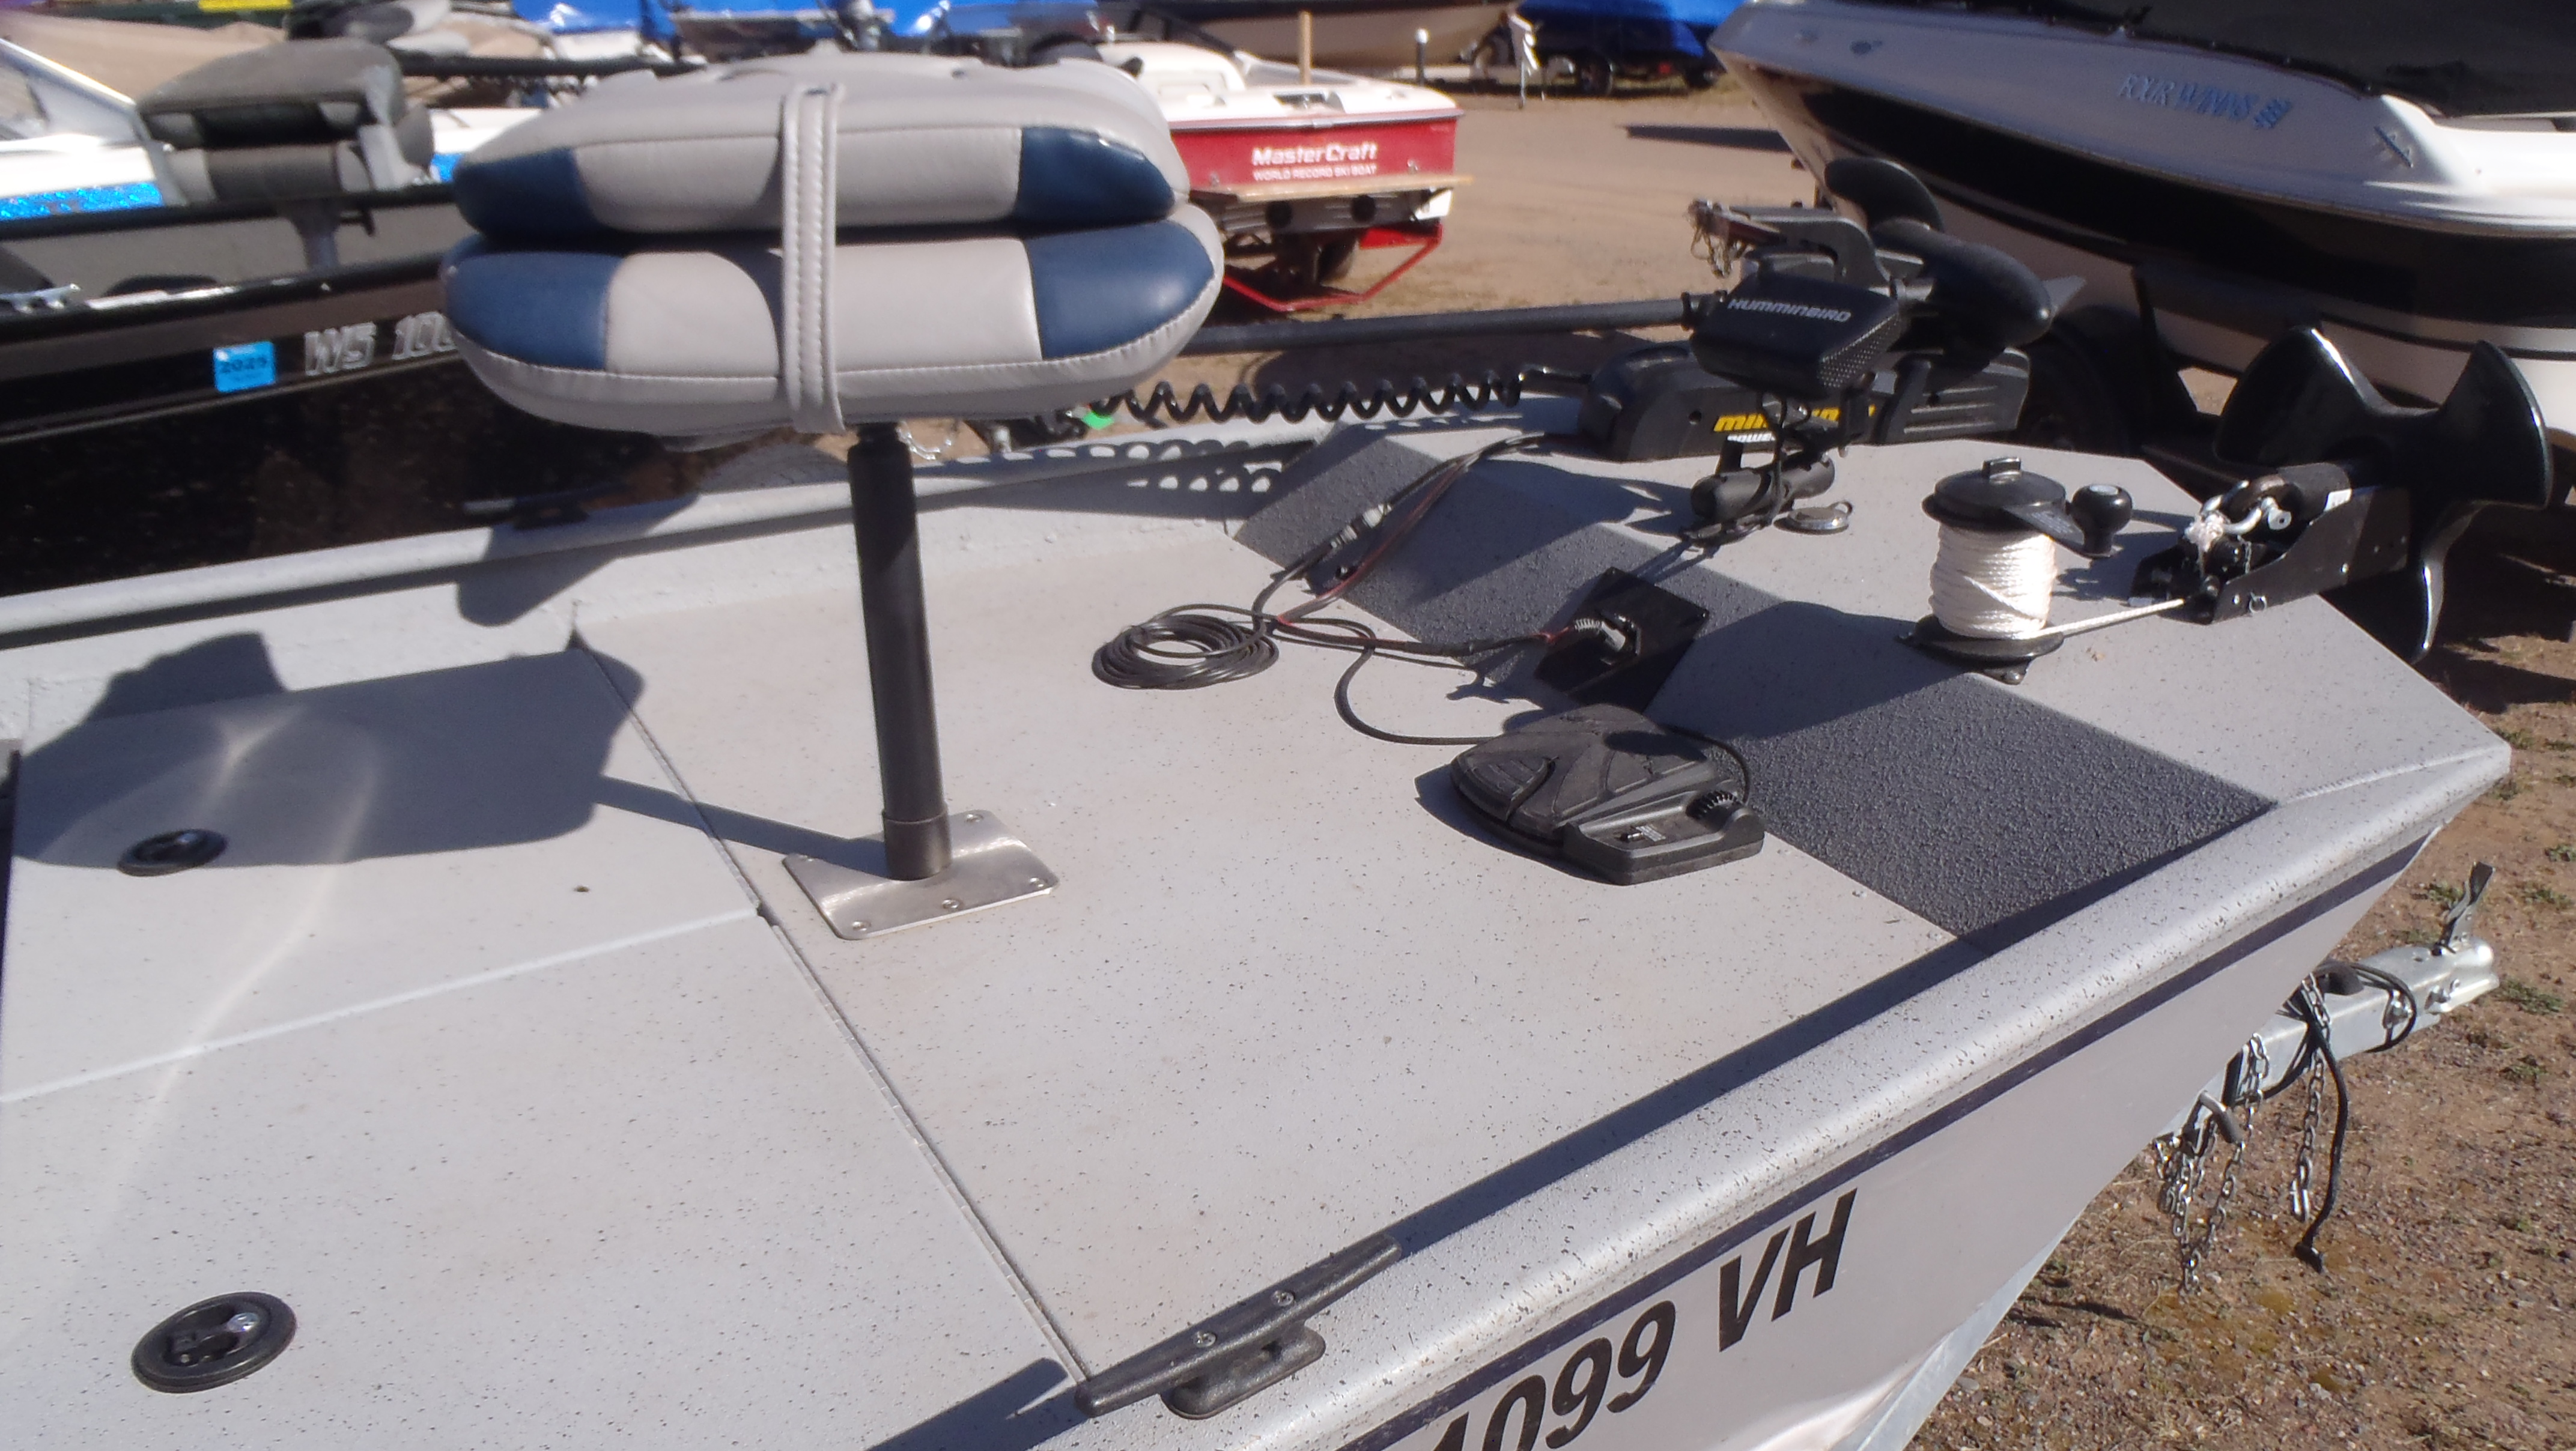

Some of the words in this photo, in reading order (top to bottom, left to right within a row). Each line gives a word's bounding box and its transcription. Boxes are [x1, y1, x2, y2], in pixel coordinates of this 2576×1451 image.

[1252, 142, 1378, 165] MasterCraft
[1253, 168, 1291, 180] WORLD
[1292, 166, 1333, 178] RECORD
[1350, 163, 1378, 175] BOAT
[1719, 1187, 1858, 1353] VH
